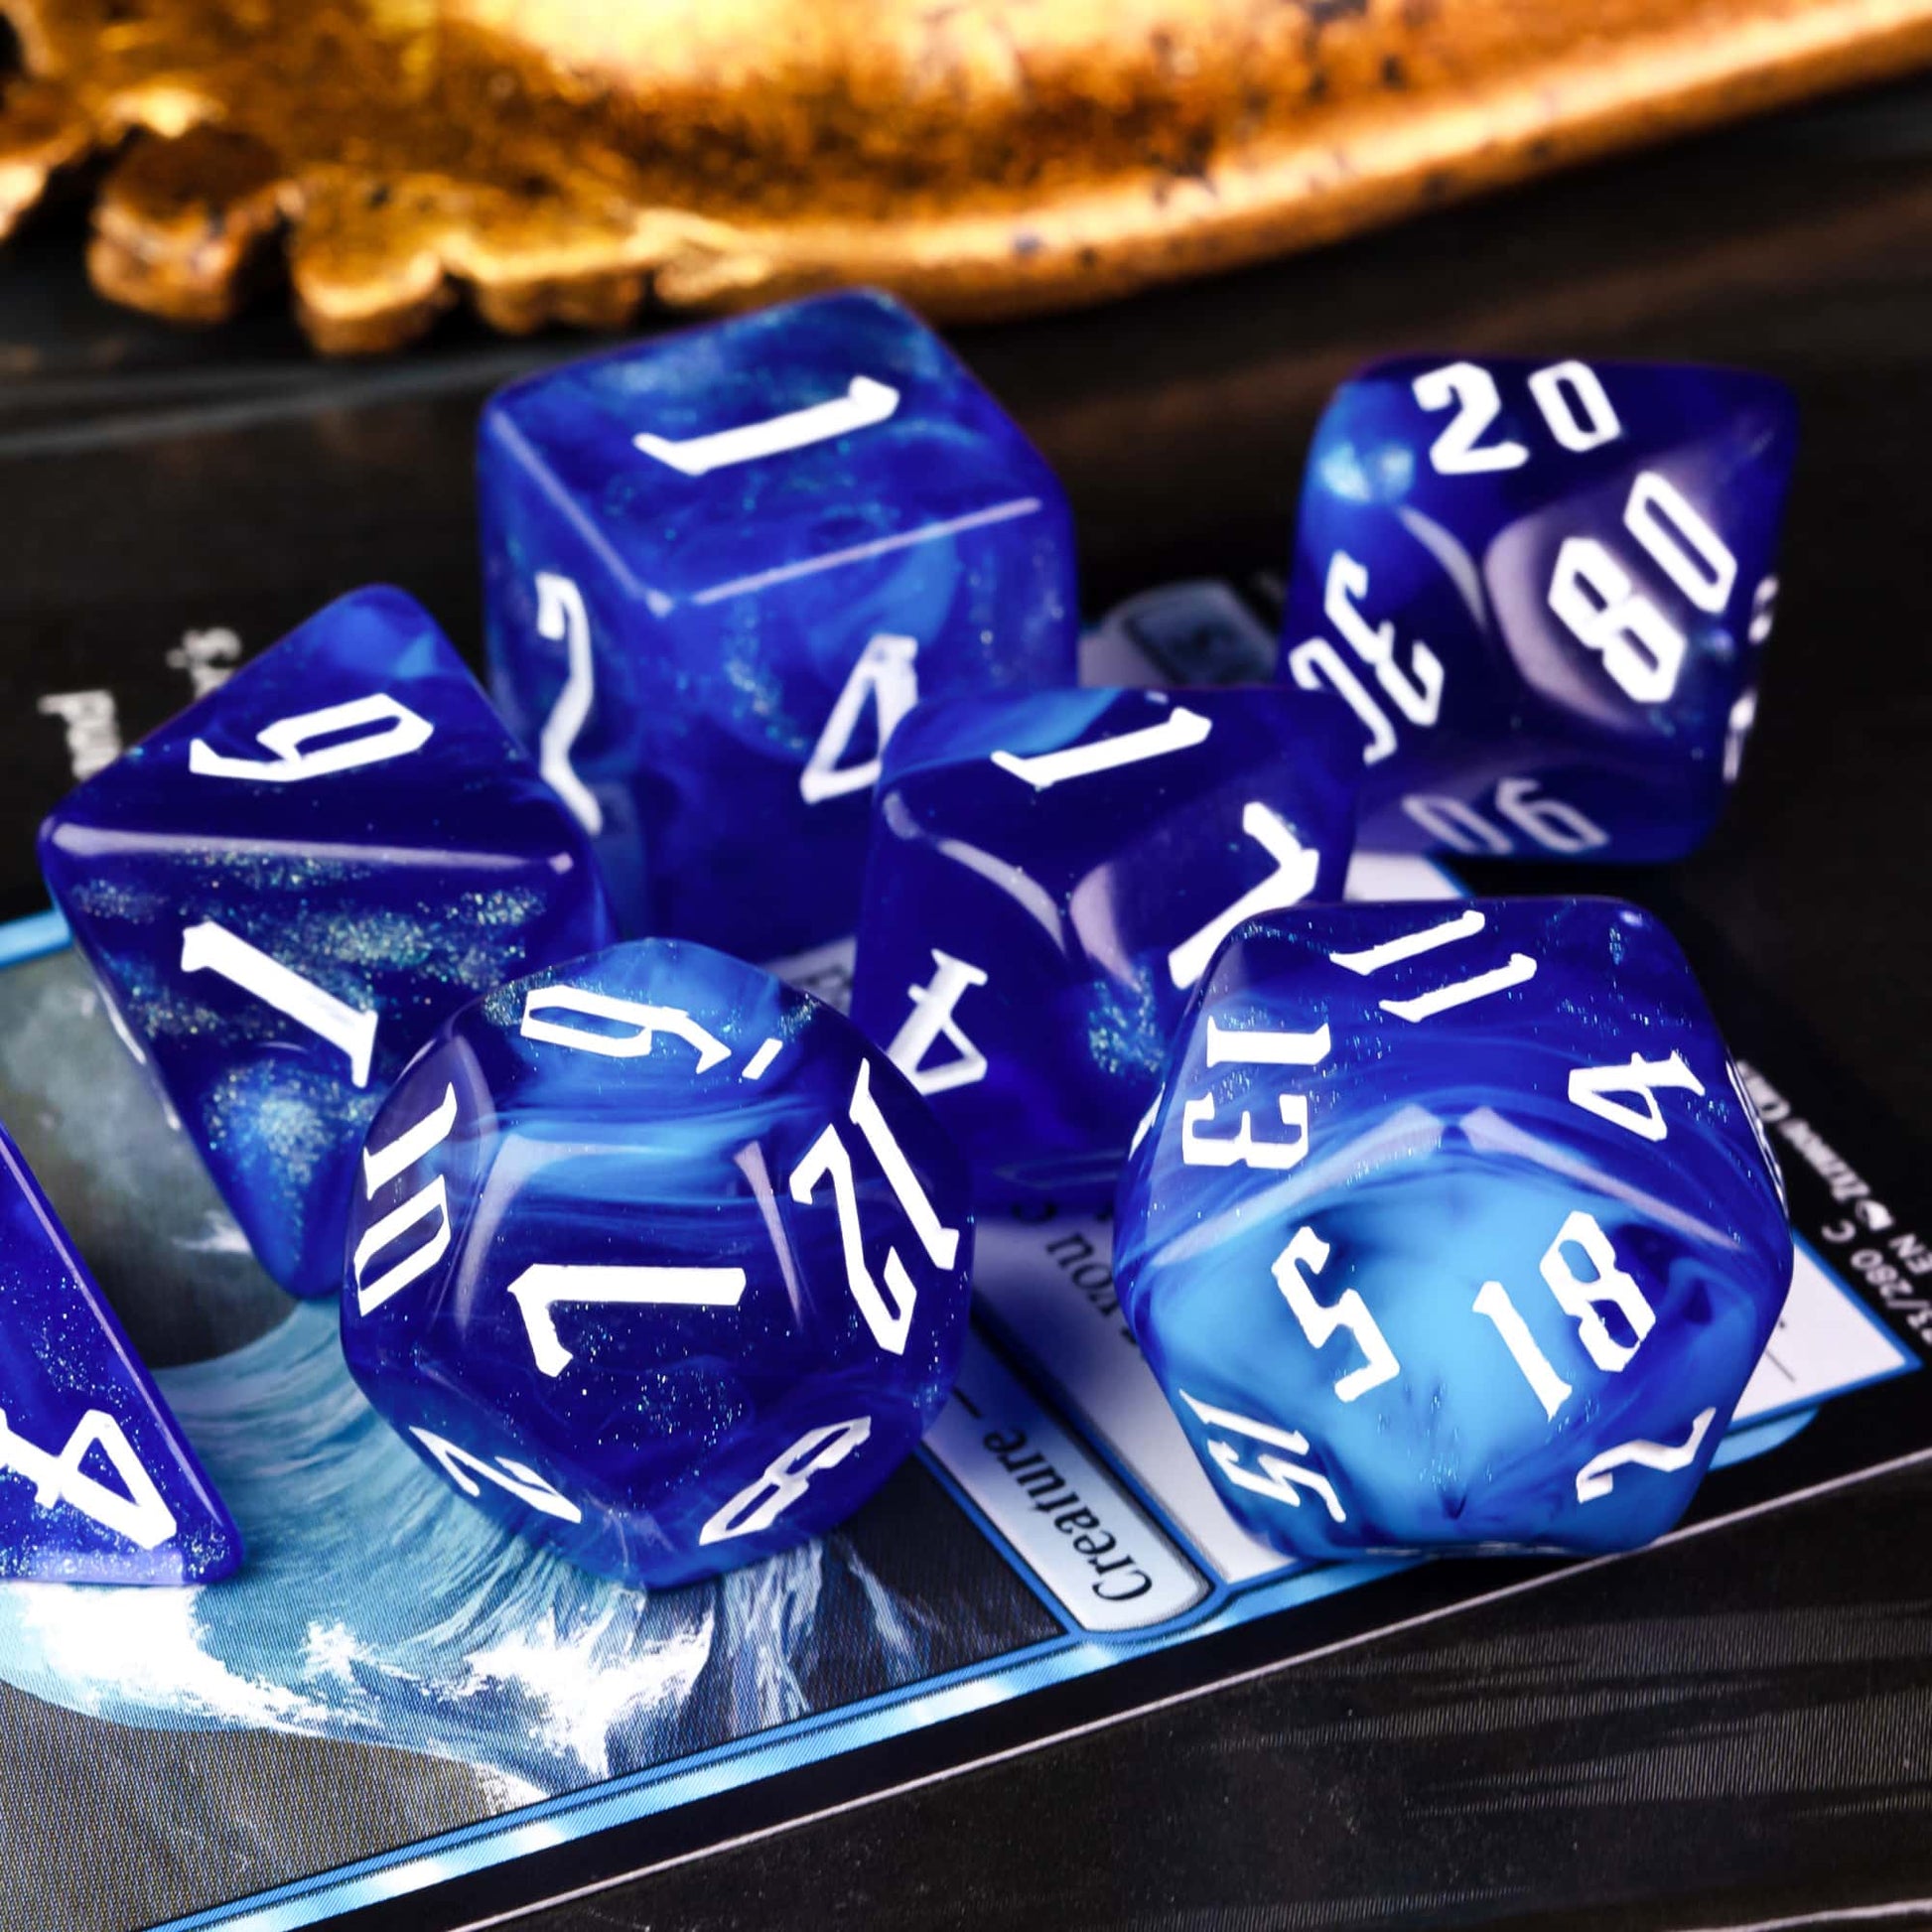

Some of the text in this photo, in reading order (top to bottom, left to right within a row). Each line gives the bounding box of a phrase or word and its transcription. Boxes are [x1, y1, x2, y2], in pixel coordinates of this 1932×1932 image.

[633, 375, 899, 476] 1
[1413, 360, 1620, 475] 20
[1547, 471, 1738, 703] 80
[536, 574, 600, 831] 2
[991, 706, 1213, 789] 1
[1167, 800, 1322, 991] 7
[1328, 907, 1539, 1025] 11
[180, 919, 379, 1089] 1
[886, 947, 989, 1096] 4
[1179, 1015, 1333, 1172] 13
[1567, 1048, 1707, 1143] 4
[352, 1081, 459, 1318] 10
[789, 1056, 962, 1357] 12
[1270, 1225, 1401, 1404] 5
[1471, 1209, 1658, 1422] 18
[0, 1407, 179, 1552] 4
[408, 1425, 584, 1525] 2
[698, 1421, 872, 1547] 8
[982, 1426, 1153, 1602] Creature
[1177, 1387, 1348, 1524] 15
[1575, 1405, 1719, 1505] 2
